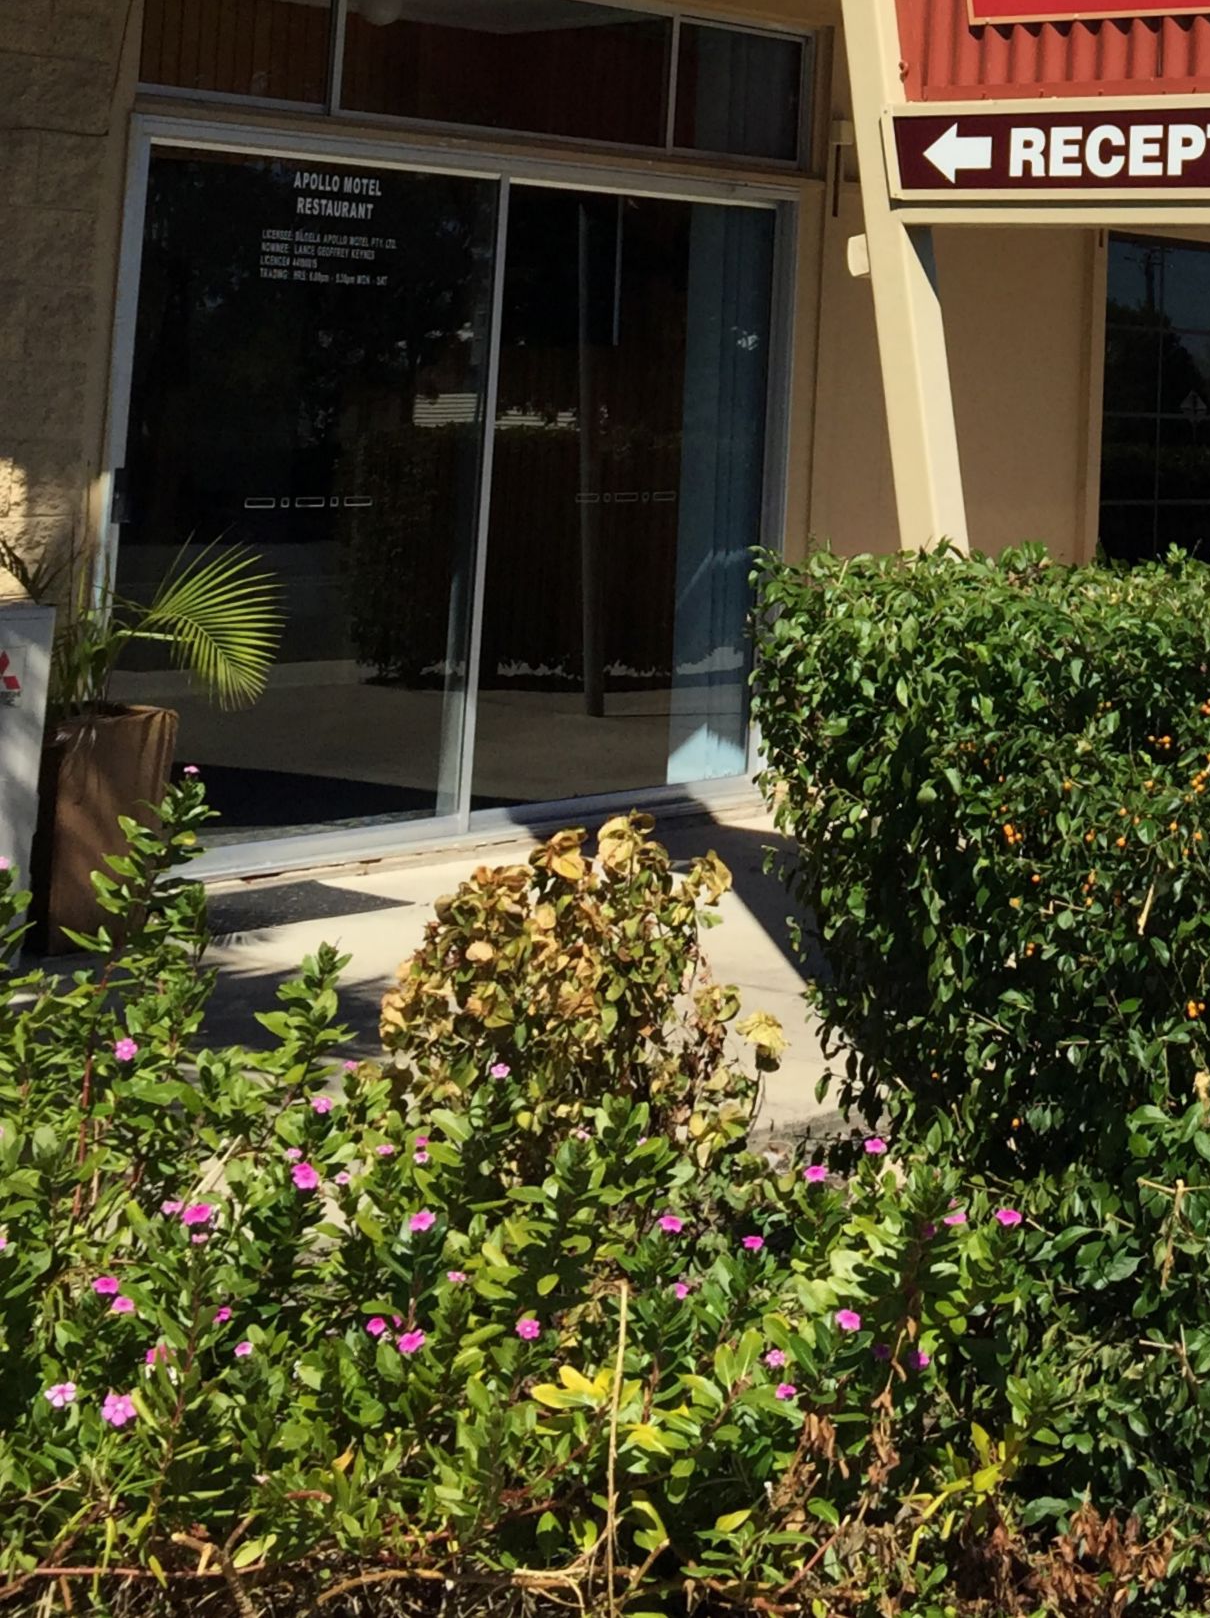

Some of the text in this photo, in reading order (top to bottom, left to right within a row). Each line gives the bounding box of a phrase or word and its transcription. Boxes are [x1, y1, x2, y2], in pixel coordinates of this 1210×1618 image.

[293, 171, 382, 196] APOLLO MOTEL
[296, 197, 374, 220] RESTAURANT
